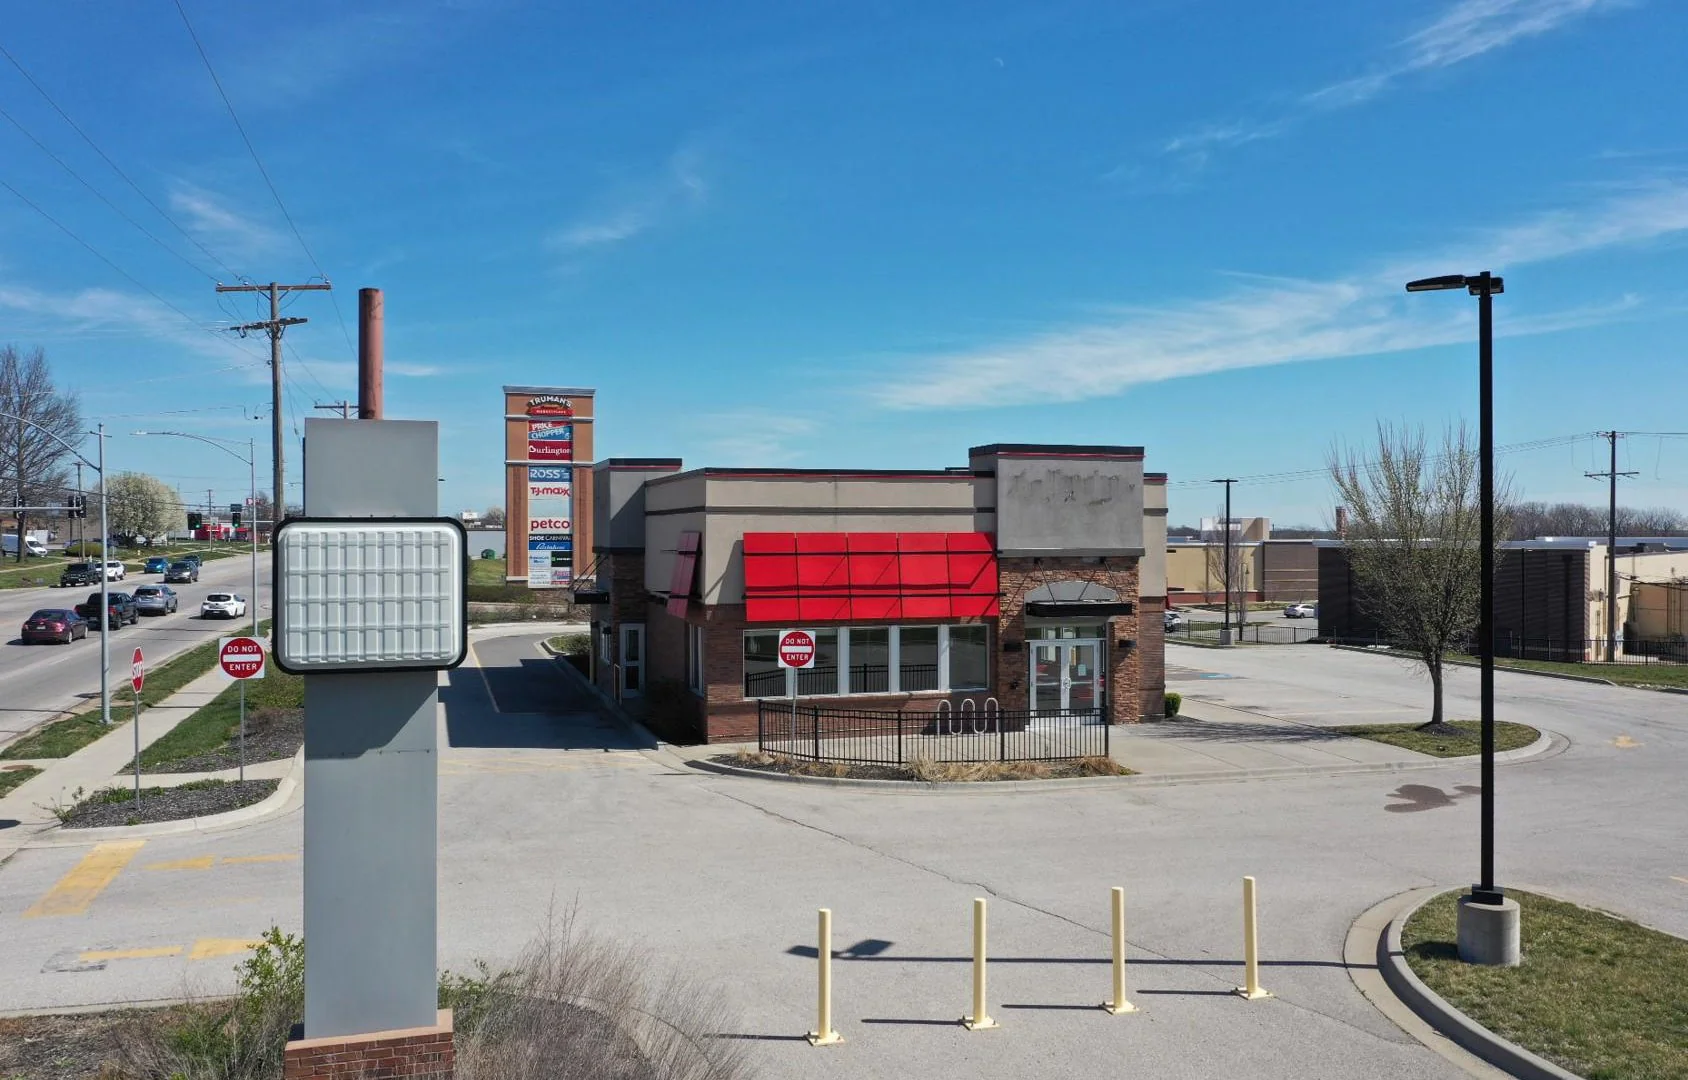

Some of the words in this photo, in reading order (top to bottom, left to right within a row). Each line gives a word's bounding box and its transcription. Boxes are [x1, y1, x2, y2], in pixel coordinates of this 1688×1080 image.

[529, 395, 572, 407] TRUMAN'S
[529, 445, 571, 456] Burlington
[530, 469, 560, 478] ROSS
[531, 518, 570, 531] petco
[227, 645, 239, 653] DO
[241, 645, 258, 653] NOT
[786, 653, 809, 661] ENTER
[132, 661, 143, 680] STOP
[229, 663, 257, 671] ENTER
